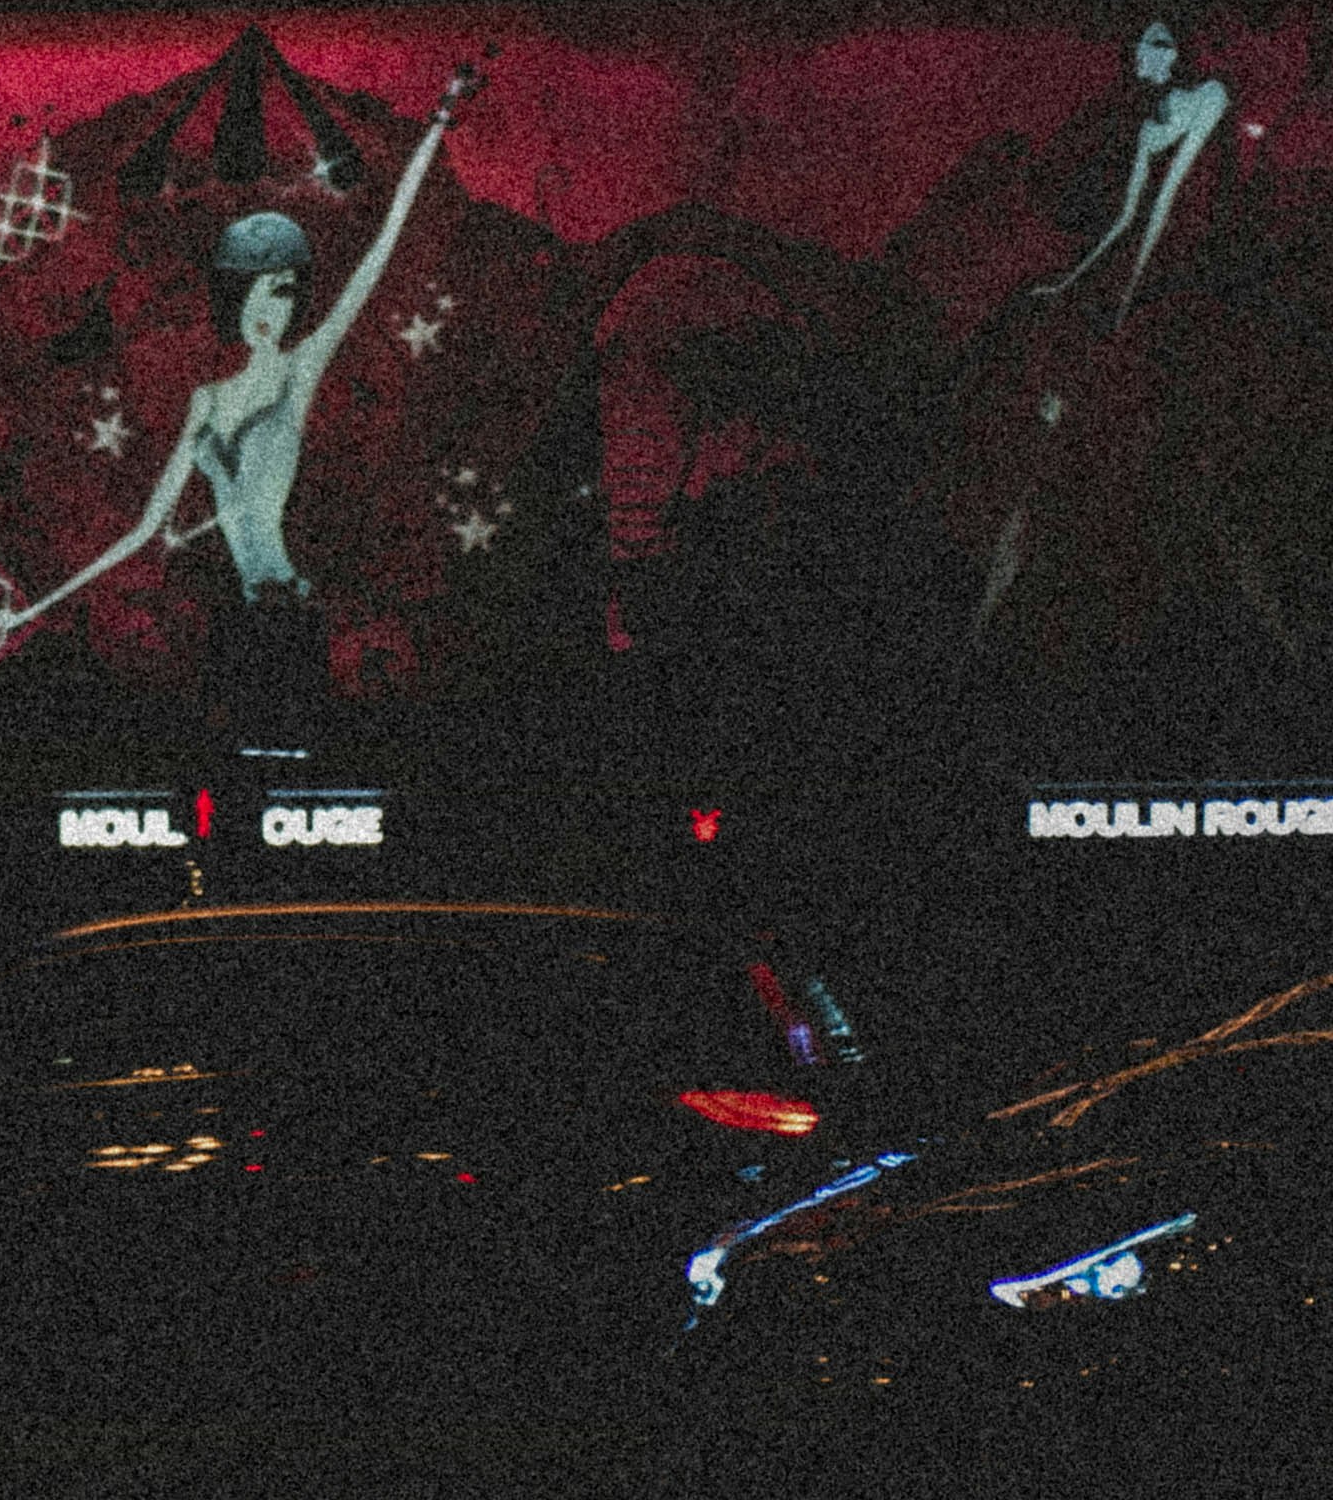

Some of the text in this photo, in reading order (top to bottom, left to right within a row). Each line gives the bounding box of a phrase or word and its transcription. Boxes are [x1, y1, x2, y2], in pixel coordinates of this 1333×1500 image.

[59, 806, 383, 846] MOUL OUGE
[1029, 799, 1333, 837] MOULIN ROUG
